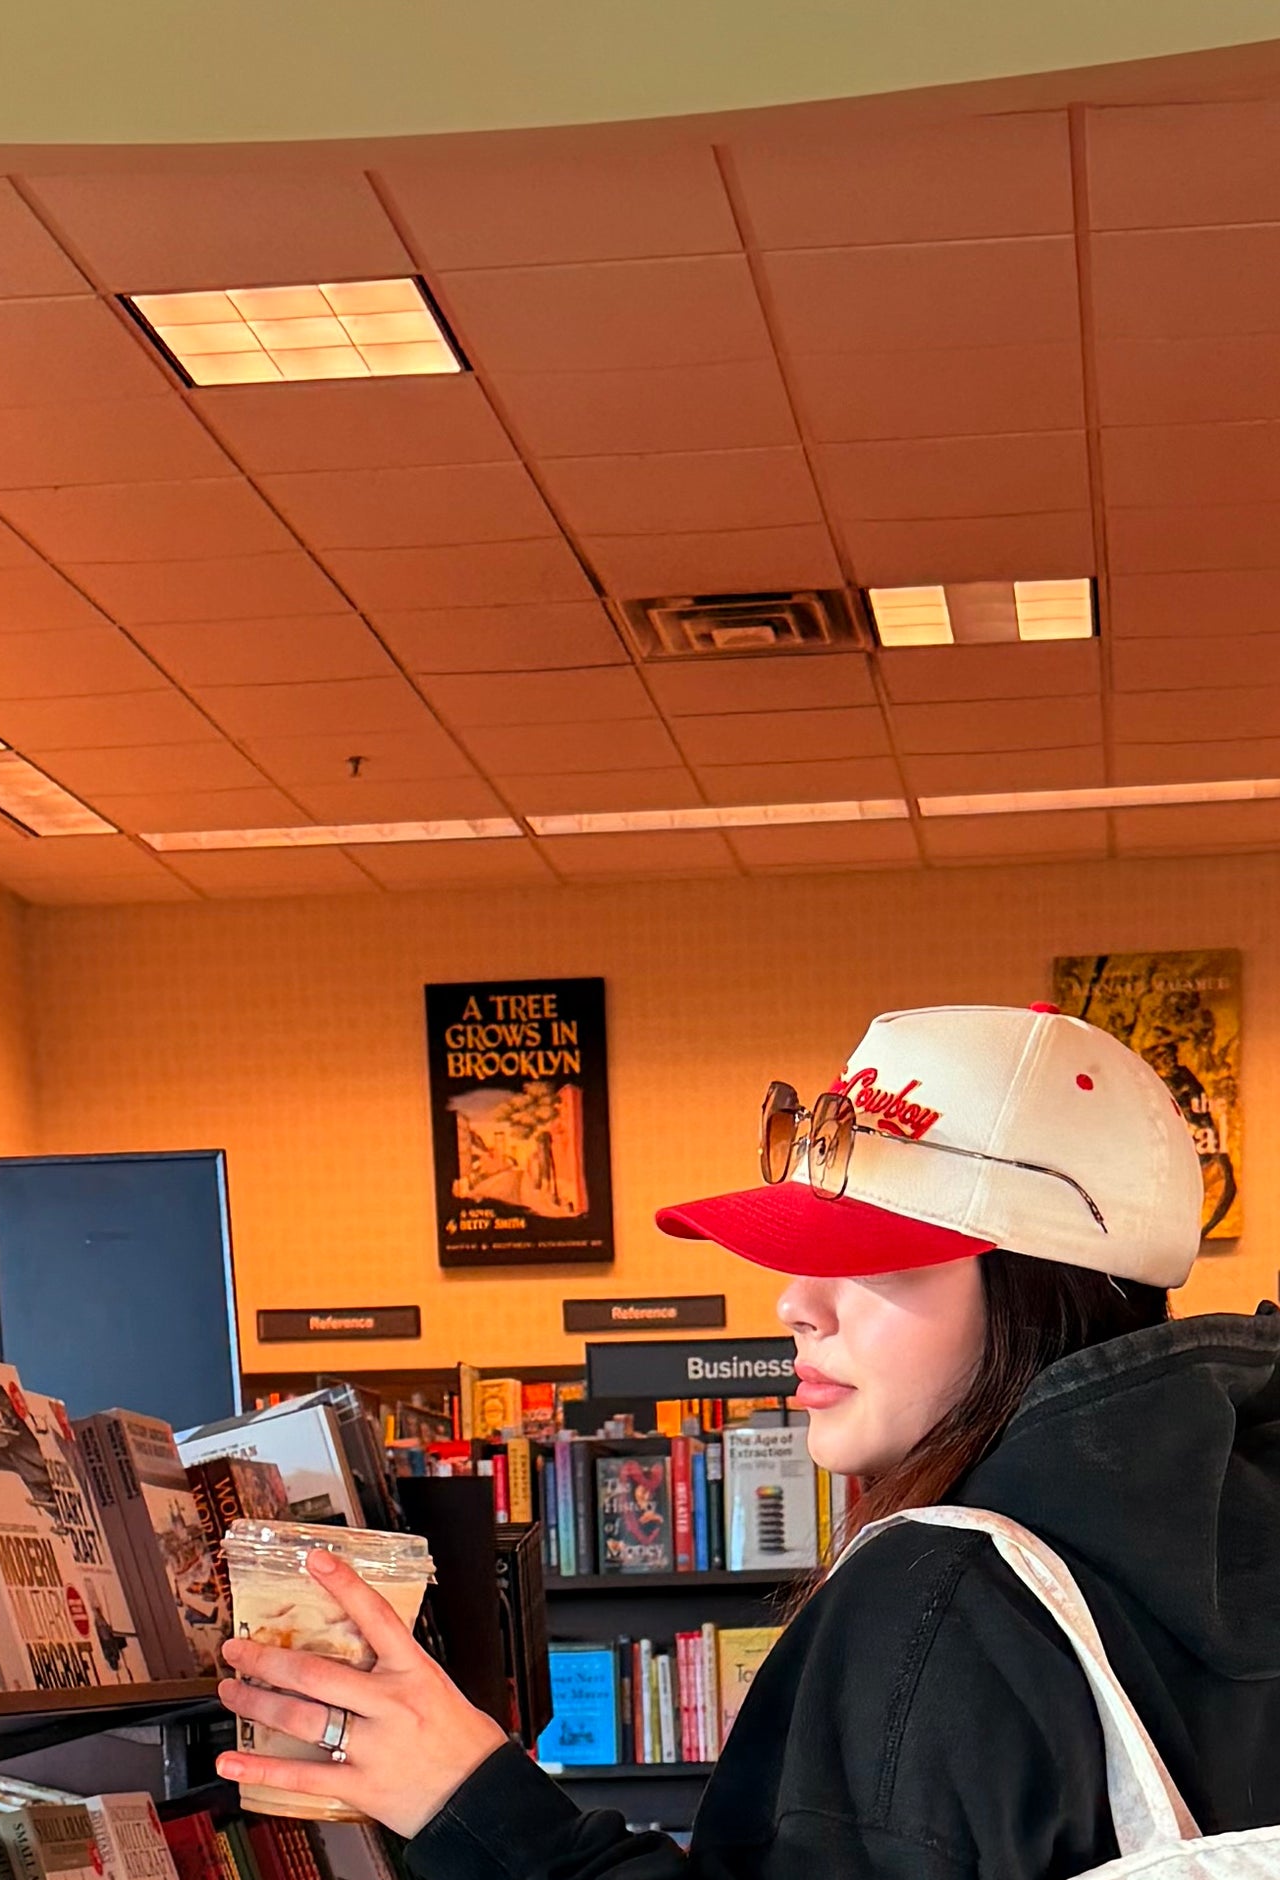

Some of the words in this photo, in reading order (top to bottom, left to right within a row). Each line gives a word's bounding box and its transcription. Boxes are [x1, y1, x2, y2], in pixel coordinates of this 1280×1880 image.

[463, 996, 482, 1020] A
[490, 993, 558, 1019] TREE
[444, 1023, 541, 1050] GROWS
[552, 1021, 578, 1046] IN
[447, 1050, 581, 1079] BROOKLYN
[837, 1067, 941, 1141] Cowboy
[611, 1305, 676, 1320] Reference
[687, 1357, 794, 1380] Business
[26, 1641, 102, 1690] AIRCRAFT
[14, 1822, 34, 1868] SMALL
